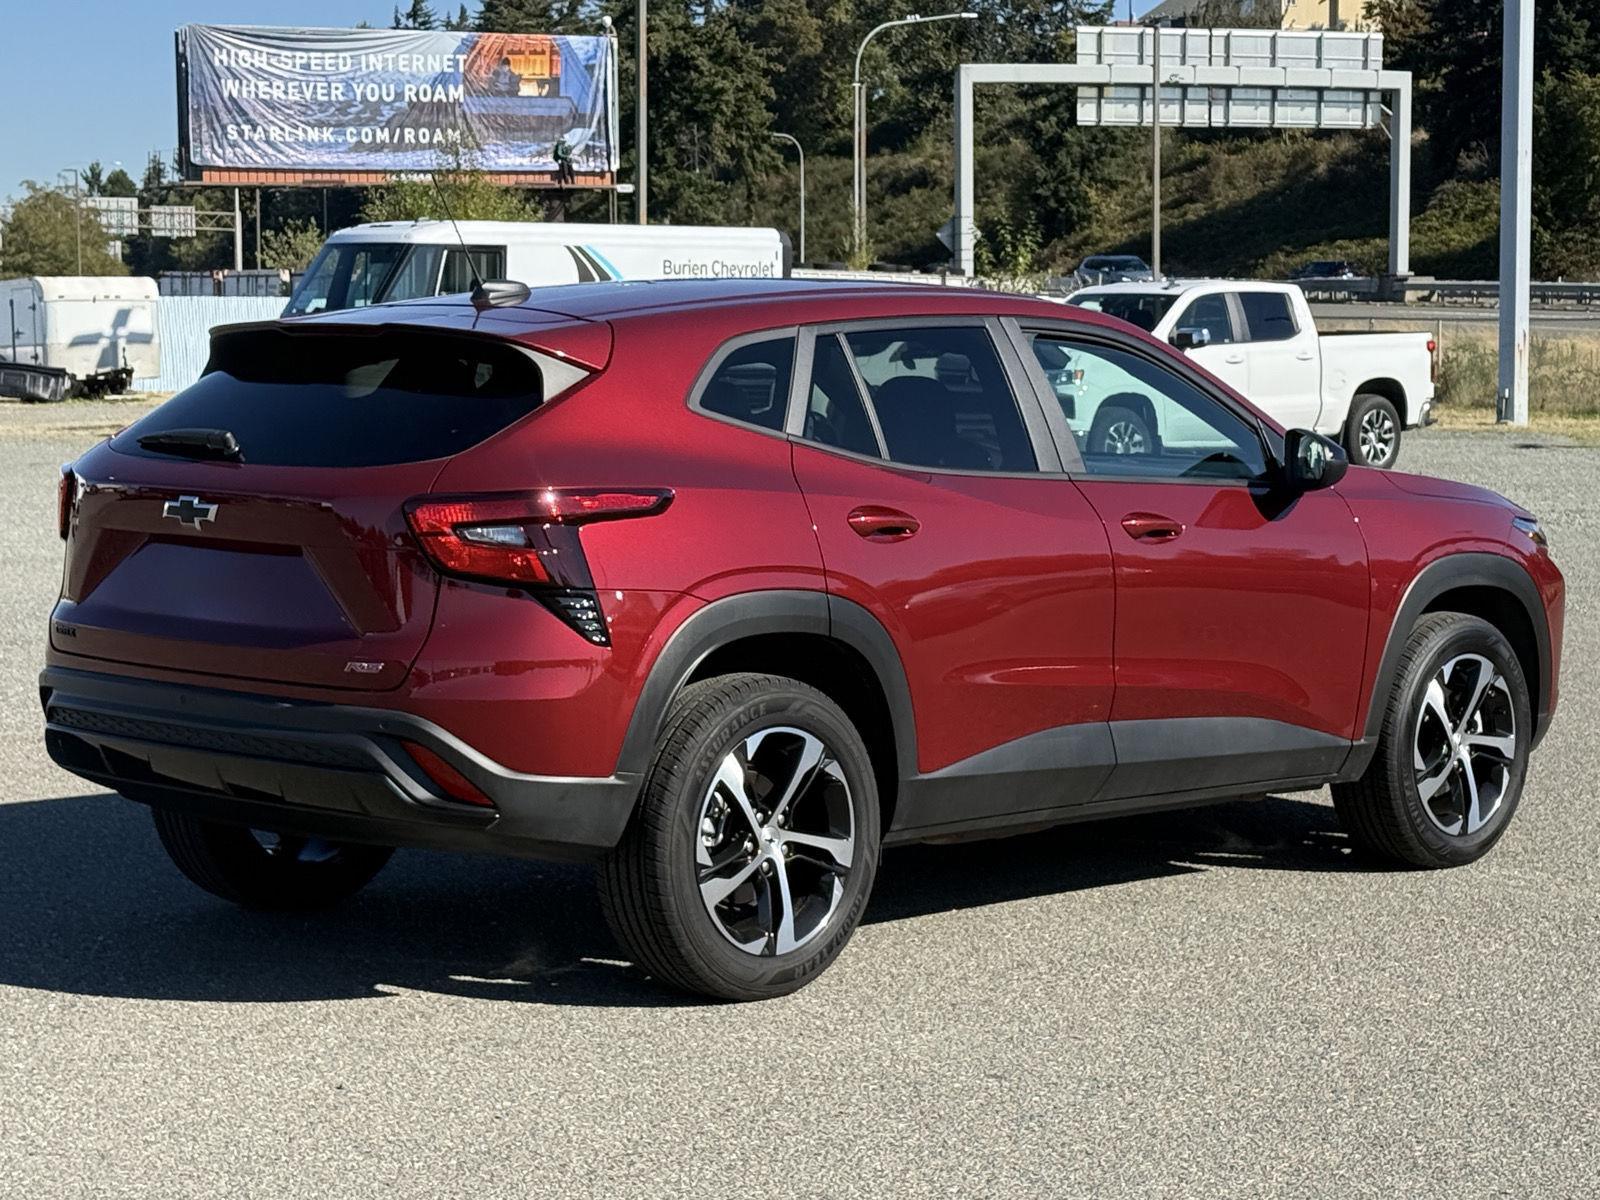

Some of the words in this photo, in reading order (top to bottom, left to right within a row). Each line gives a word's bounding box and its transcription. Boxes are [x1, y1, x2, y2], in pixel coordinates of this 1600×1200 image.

[213, 47, 352, 71] HIGH-SPEED
[361, 53, 467, 73] INTERNET
[221, 78, 344, 101] WHEREVER
[353, 82, 395, 102] YOU
[404, 83, 464, 103] ROAM
[226, 124, 461, 144] STARLINK.COM/ROAM
[663, 259, 707, 276] Burien
[711, 259, 775, 278] Chevrolet
[344, 661, 384, 674] RS
[695, 702, 767, 783] ASSURANCE
